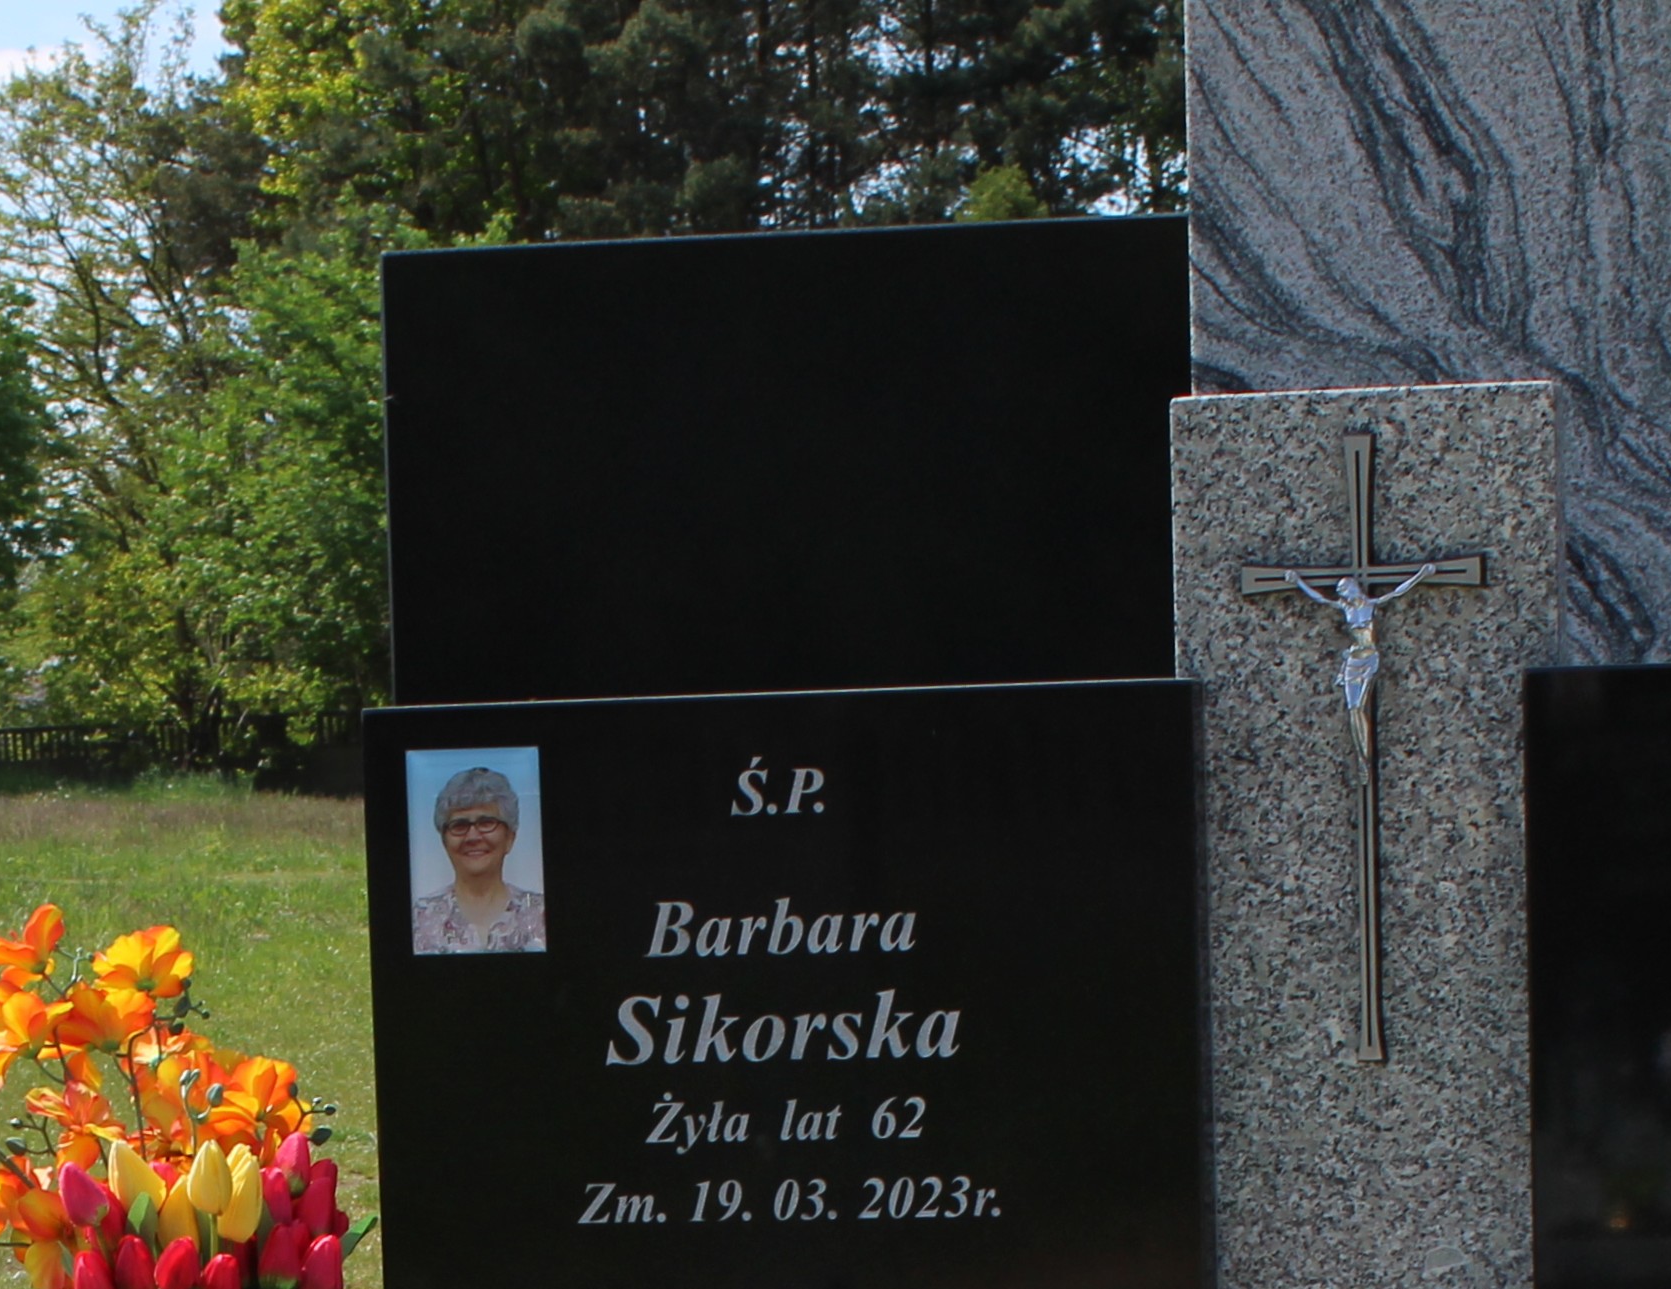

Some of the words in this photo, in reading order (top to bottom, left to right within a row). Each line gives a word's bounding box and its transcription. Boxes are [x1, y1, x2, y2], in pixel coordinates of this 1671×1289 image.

[730, 755, 826, 816] Ś.P.
[644, 896, 917, 958] Barbara
[605, 988, 962, 1066] Sikorska
[645, 1091, 750, 1155] Żyła
[780, 1098, 843, 1142] lat
[871, 1095, 927, 1140] 62
[577, 1182, 668, 1225] Zm.
[689, 1179, 754, 1222] 19.
[773, 1178, 839, 1221] 03.
[857, 1175, 1003, 1220] 2023r.
